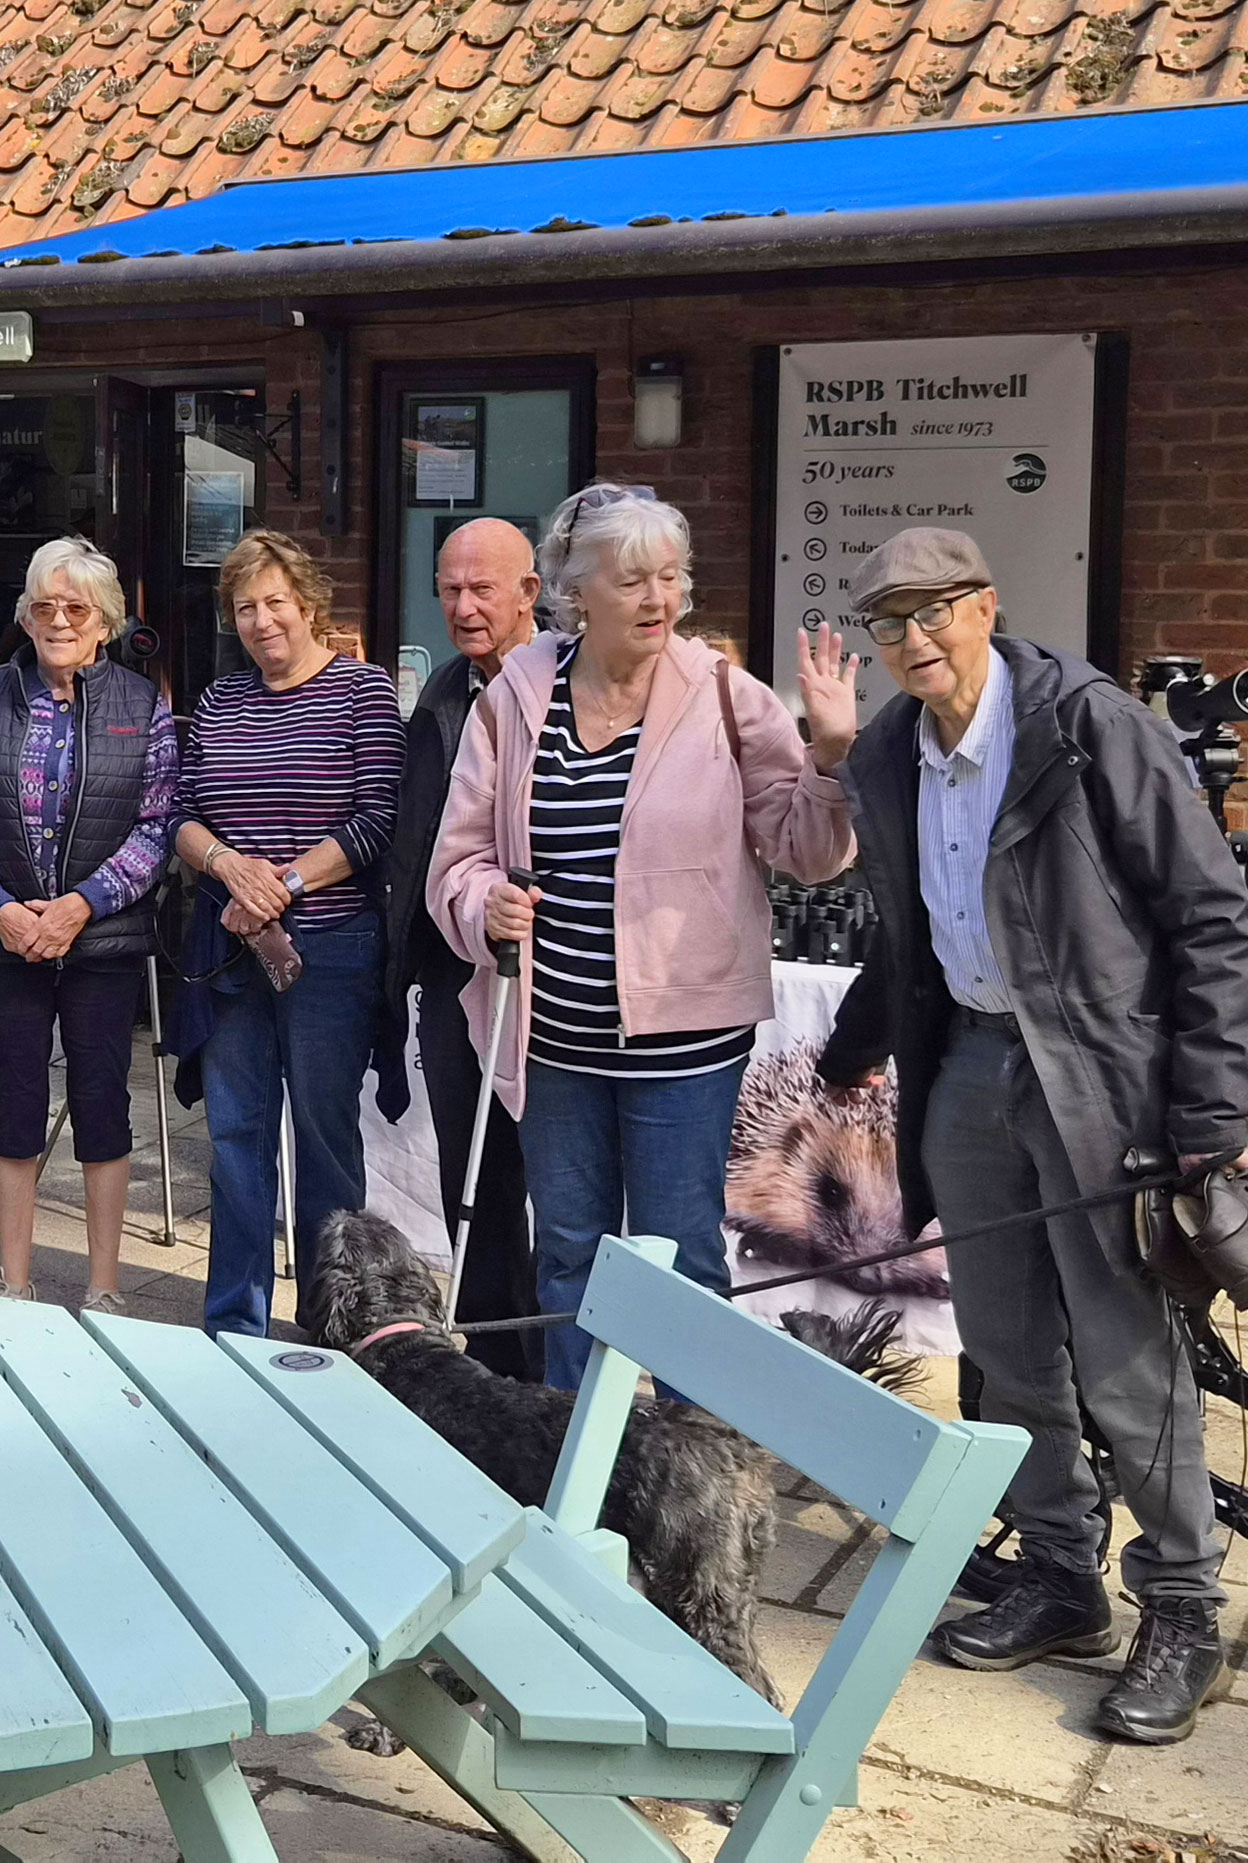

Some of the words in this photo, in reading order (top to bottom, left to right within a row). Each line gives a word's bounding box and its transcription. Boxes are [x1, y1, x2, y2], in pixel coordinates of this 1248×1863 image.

[805, 379, 885, 404] RSPB
[896, 373, 1028, 401] Titchwell
[803, 411, 897, 438] Marsh
[910, 419, 954, 436] since
[956, 421, 994, 437] 1973
[802, 460, 835, 484] 50
[835, 463, 895, 484] years
[1012, 478, 1041, 487] RSPB
[840, 504, 888, 517] Toilets
[891, 505, 902, 517] &
[906, 504, 934, 517] Car
[937, 503, 974, 516] Park
